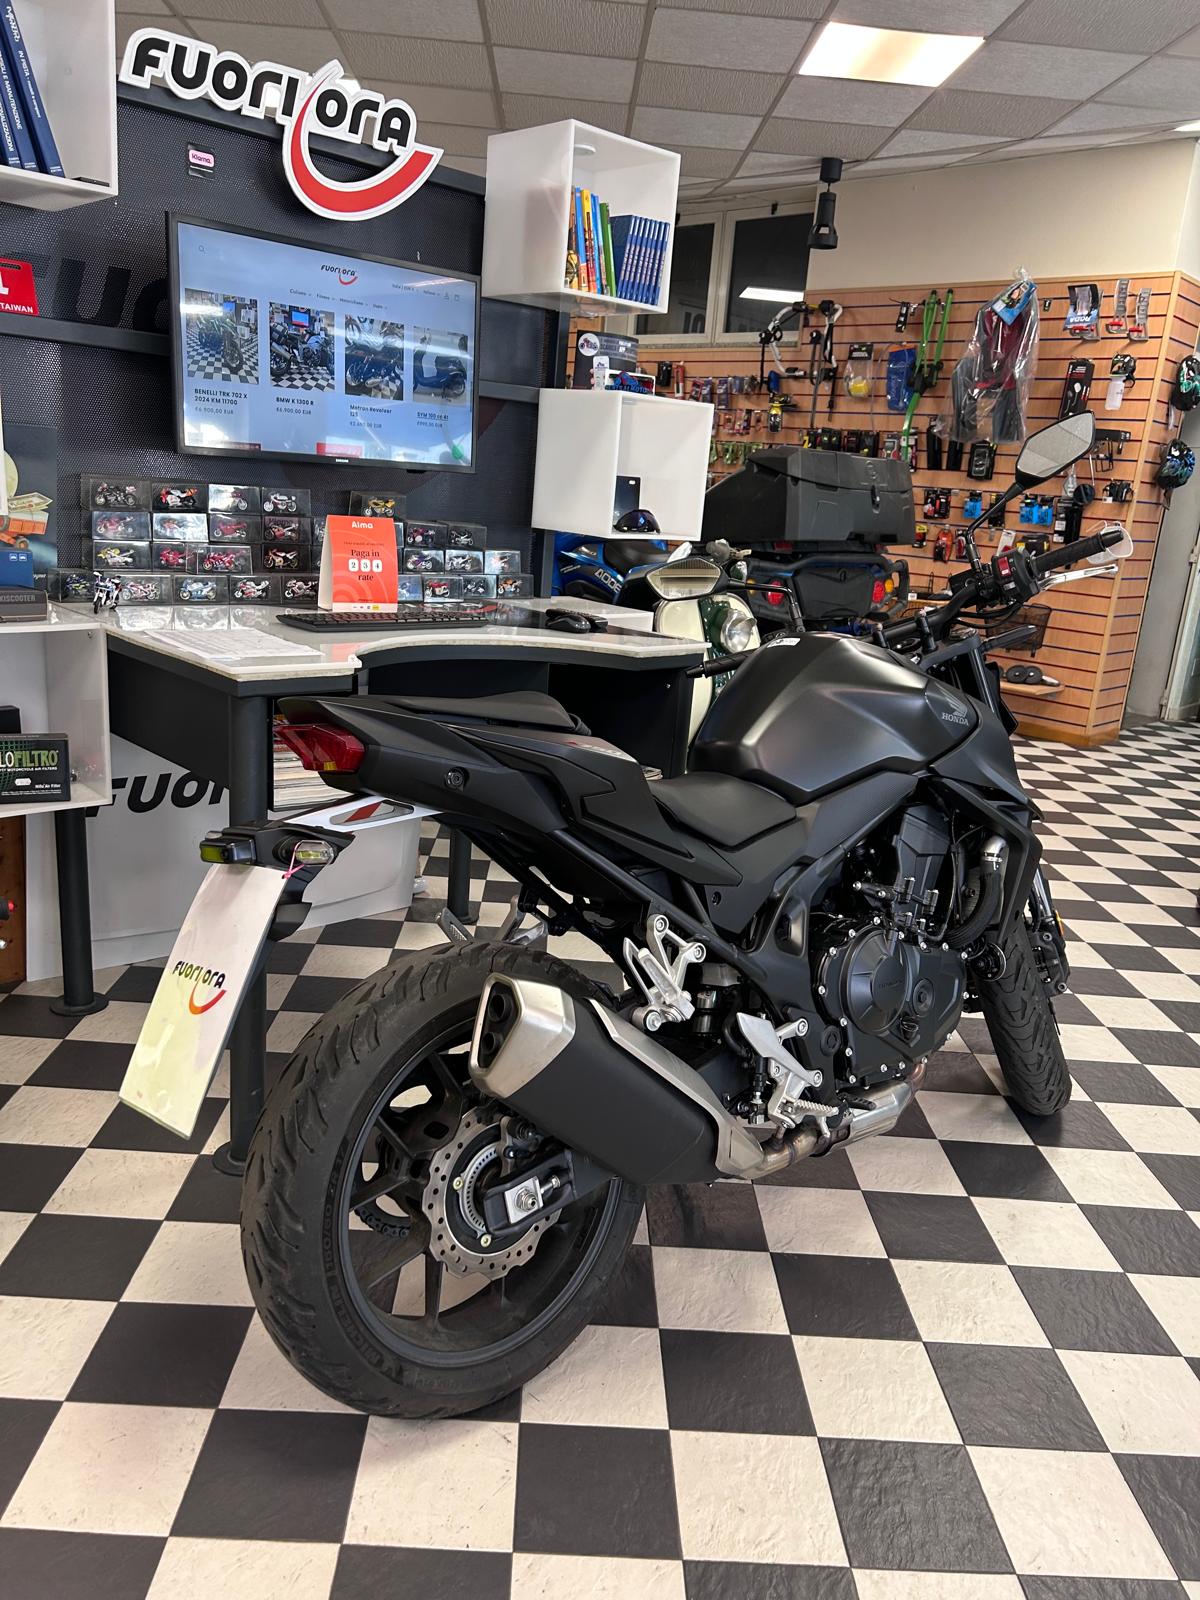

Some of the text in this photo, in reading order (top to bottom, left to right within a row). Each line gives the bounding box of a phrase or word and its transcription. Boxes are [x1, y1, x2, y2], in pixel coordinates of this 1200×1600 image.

[1, 302, 34, 314] TAIWAN
[194, 388, 218, 397] BENELLI
[231, 391, 243, 399] 702
[221, 398, 238, 406] 11700
[276, 396, 291, 404] BMW
[296, 398, 310, 406] 1300
[351, 521, 374, 529] Alma
[351, 549, 380, 558] Paga in
[358, 573, 374, 581] rate
[941, 711, 969, 726] HONDA
